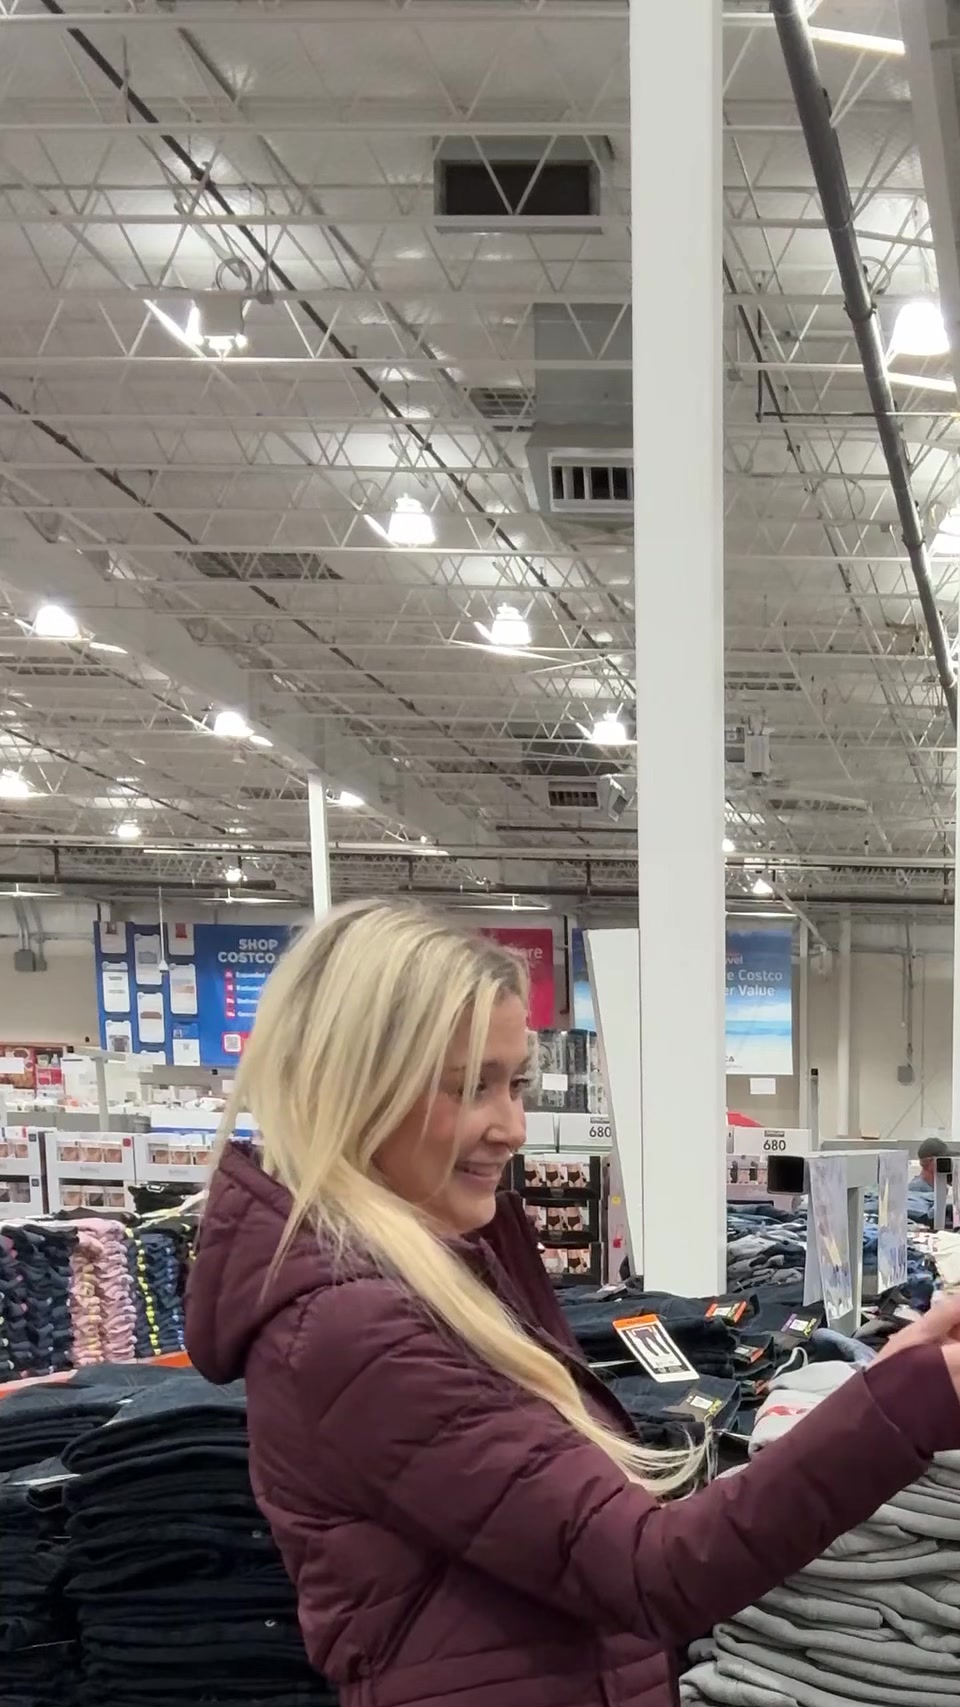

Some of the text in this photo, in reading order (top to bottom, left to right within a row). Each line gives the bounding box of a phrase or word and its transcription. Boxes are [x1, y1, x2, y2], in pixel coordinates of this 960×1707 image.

[238, 938, 279, 951] SHOP
[217, 951, 276, 964] COSTCO
[738, 969, 783, 981] Costco
[738, 984, 776, 997] Value
[589, 1126, 611, 1138] 680
[763, 1139, 787, 1151] 680
